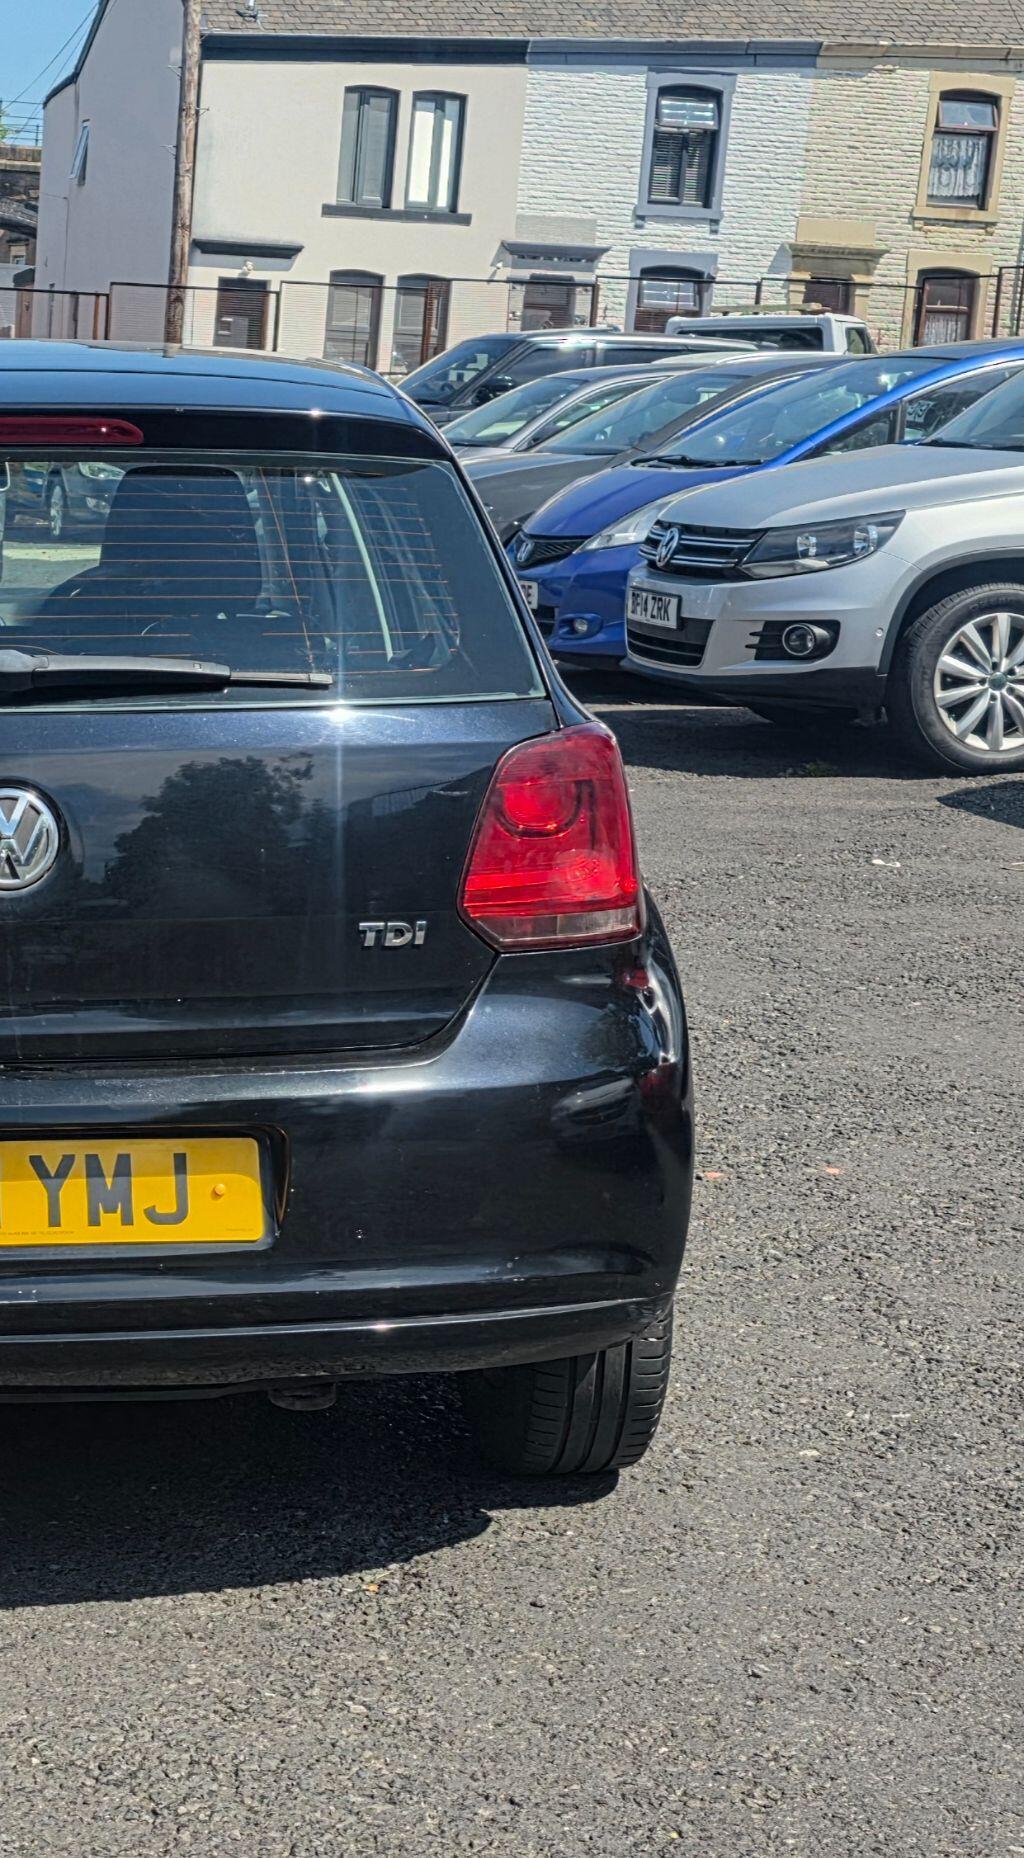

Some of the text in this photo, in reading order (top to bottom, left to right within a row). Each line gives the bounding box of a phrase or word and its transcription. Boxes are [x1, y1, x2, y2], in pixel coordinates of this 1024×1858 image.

[650, 596, 671, 622] ZRK
[358, 920, 427, 947] TDI
[28, 1152, 191, 1228] YMJ
